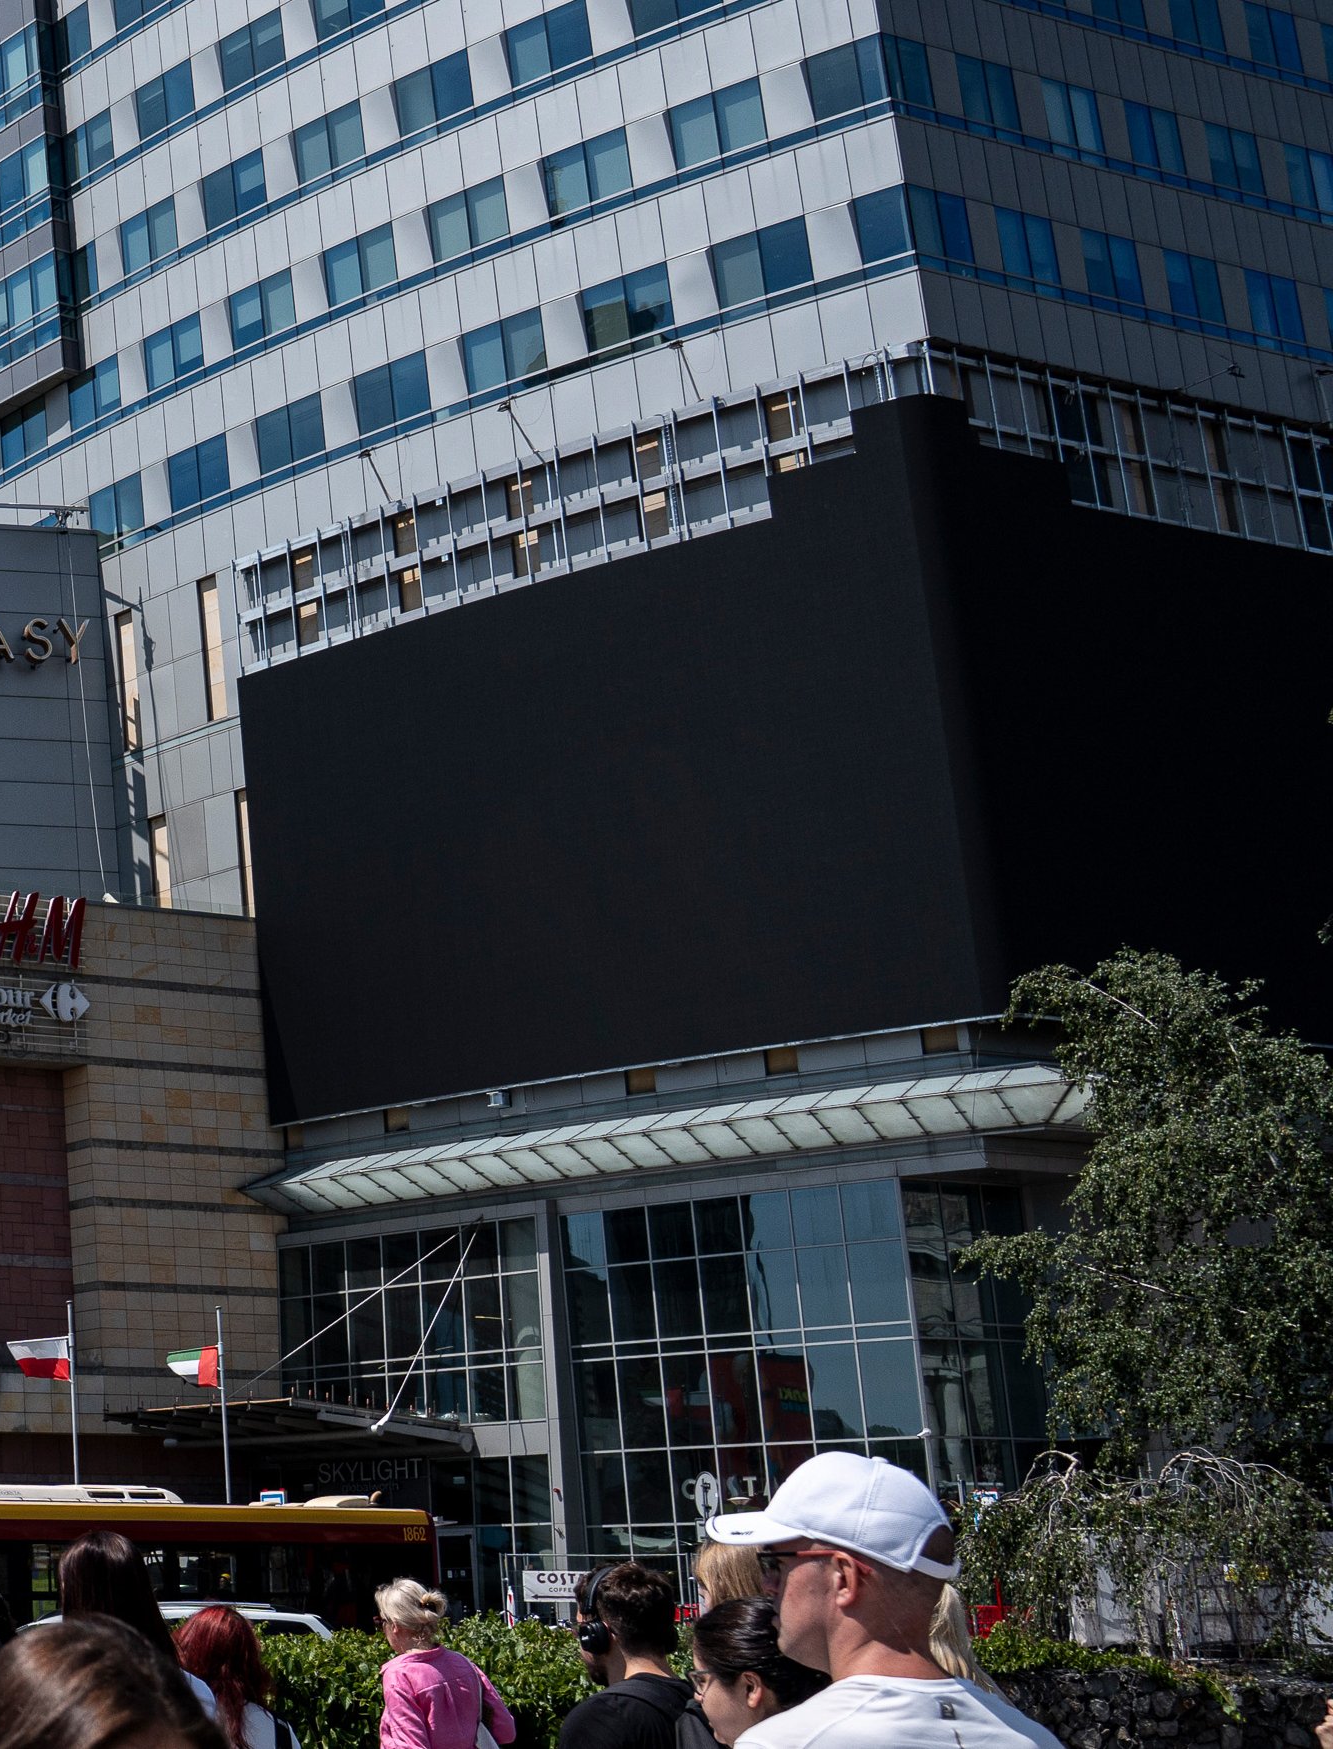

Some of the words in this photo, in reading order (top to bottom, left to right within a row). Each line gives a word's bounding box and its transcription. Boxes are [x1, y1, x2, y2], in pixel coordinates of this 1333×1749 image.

[318, 1458, 423, 1484] SKYLIGHT
[681, 1476, 780, 1500] CSTA
[403, 1526, 426, 1541] 1862
